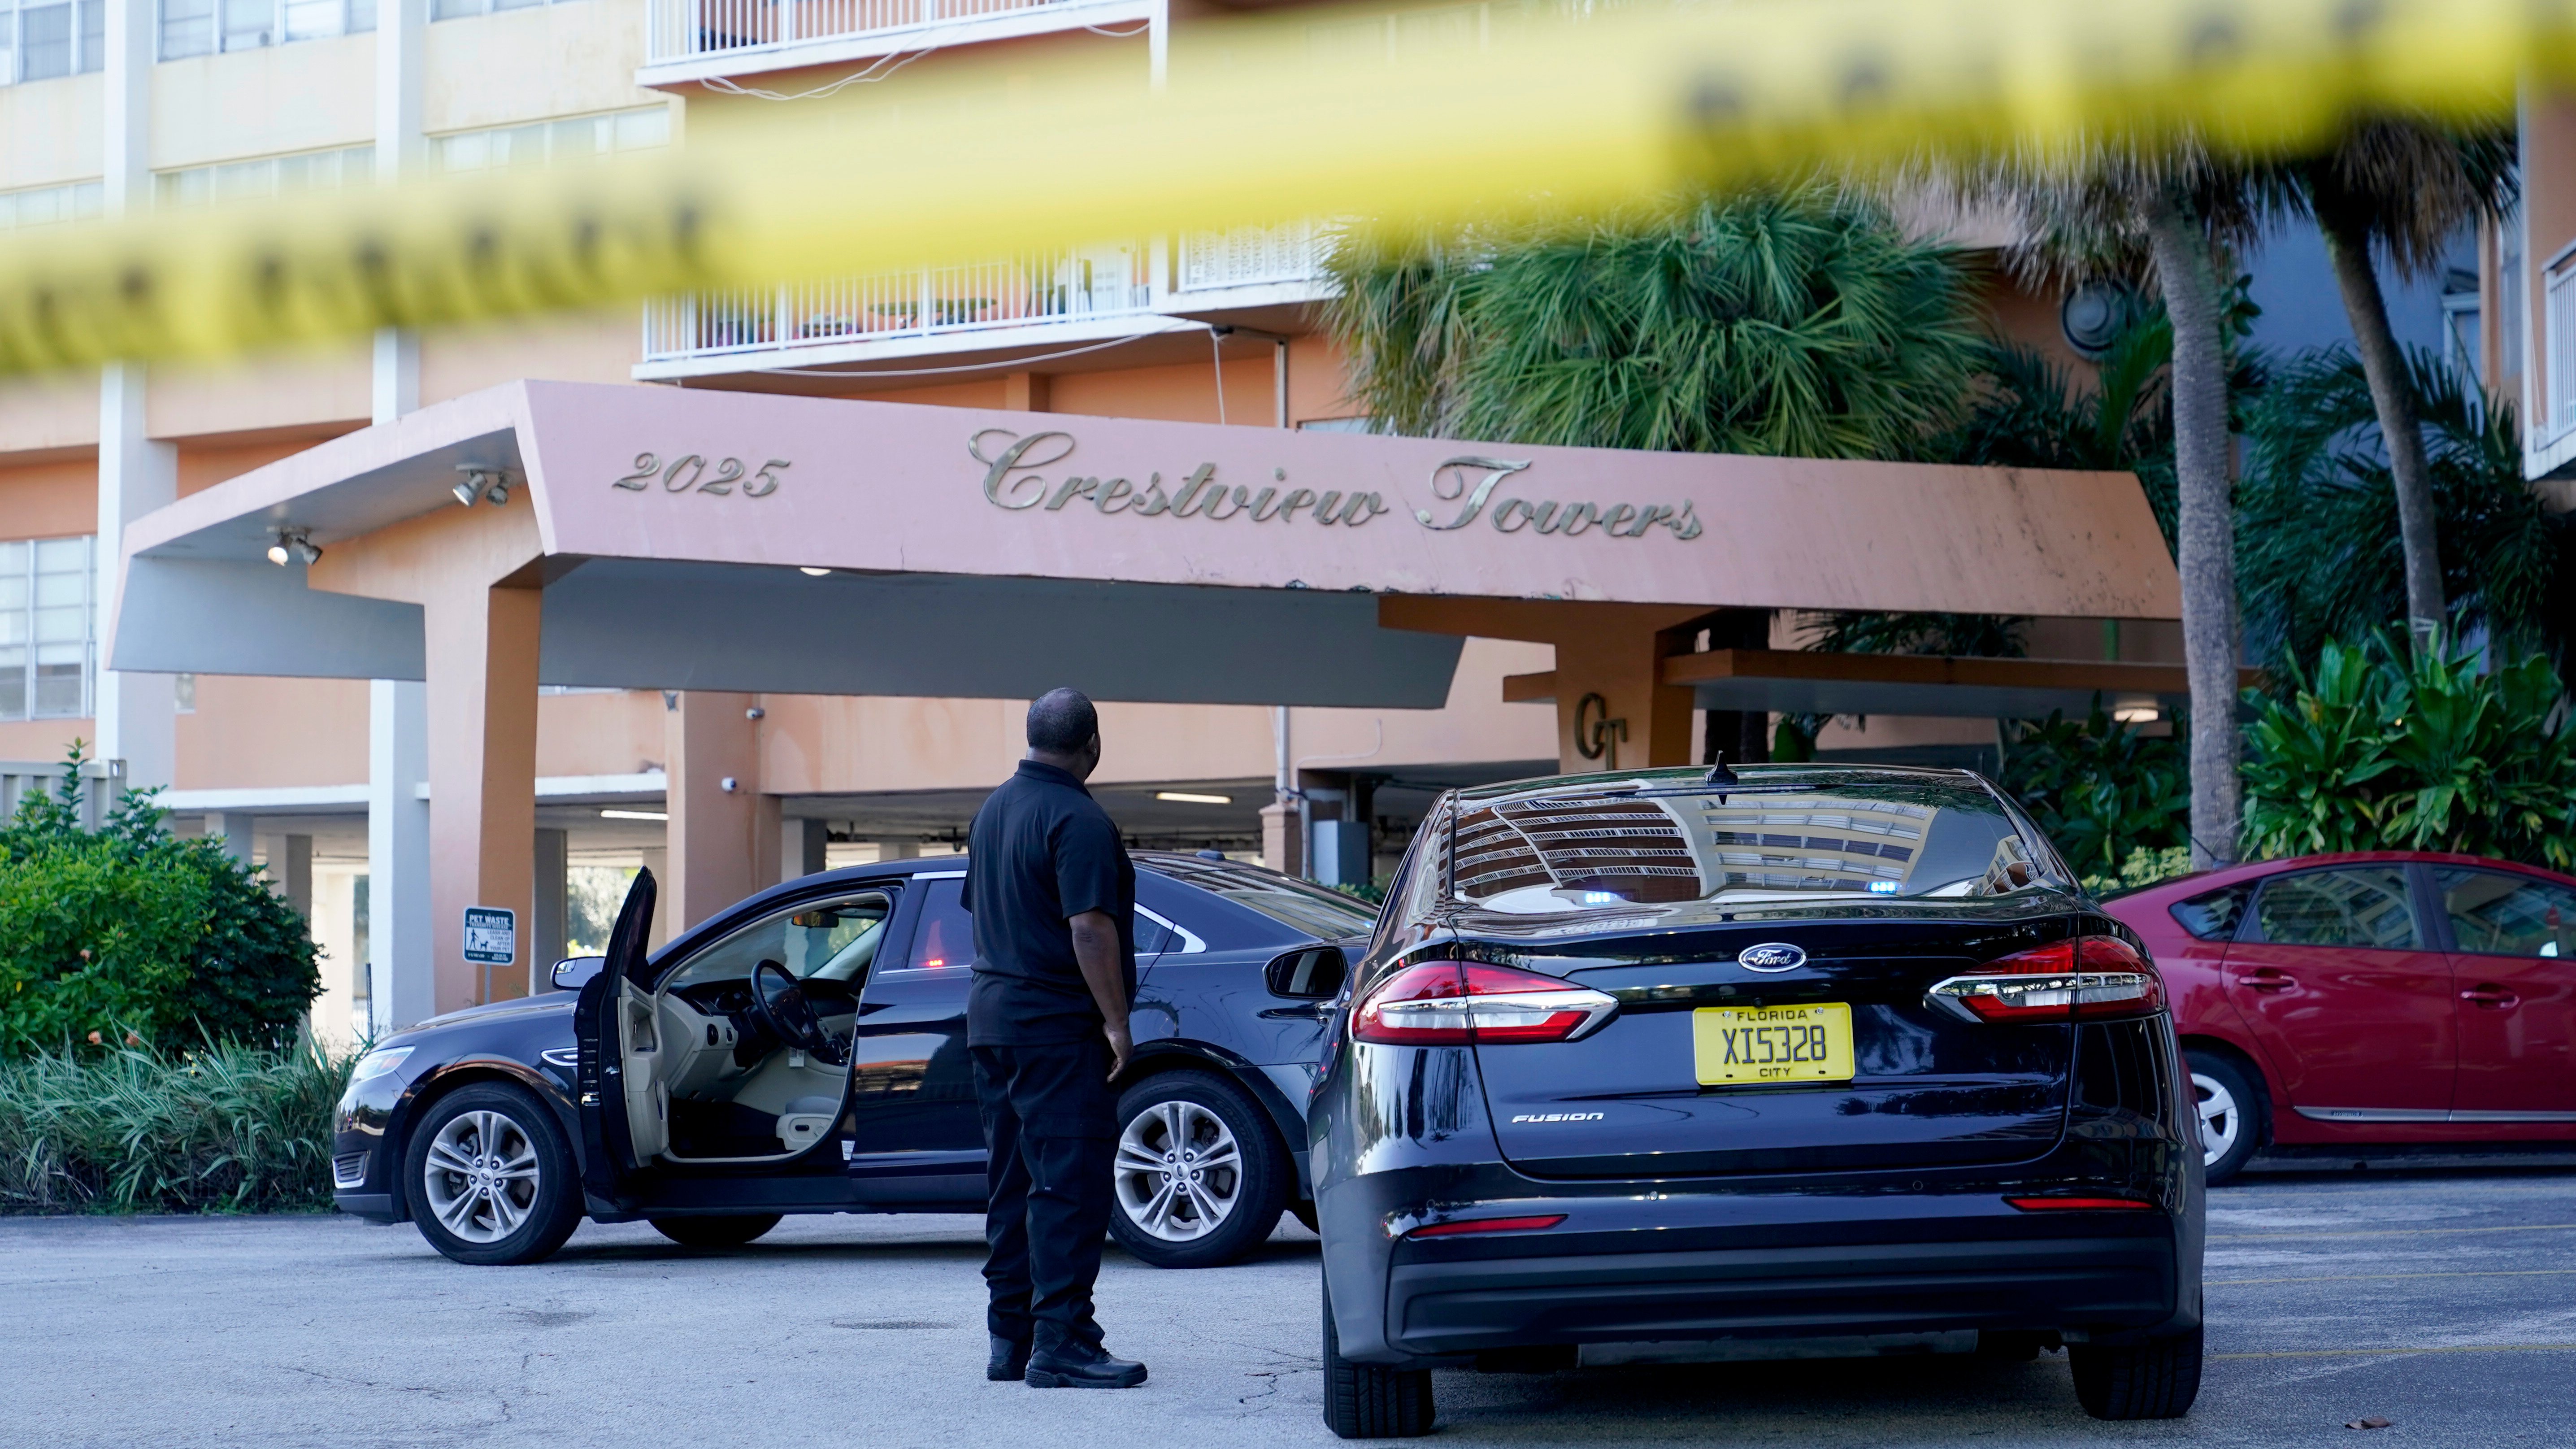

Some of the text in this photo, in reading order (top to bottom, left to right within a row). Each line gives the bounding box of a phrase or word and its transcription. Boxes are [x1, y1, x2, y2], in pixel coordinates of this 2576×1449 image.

[612, 452, 791, 497] 2025
[969, 429, 1703, 540] Crestview Towers
[469, 914, 509, 925] PET WASTE
[1754, 949, 1792, 966] Ford
[1737, 1010, 1807, 1021] FLORIDA
[1722, 1025, 1826, 1065] XI5328
[1759, 1068, 1791, 1077] CITY
[1512, 1112, 1604, 1123] FUSION
